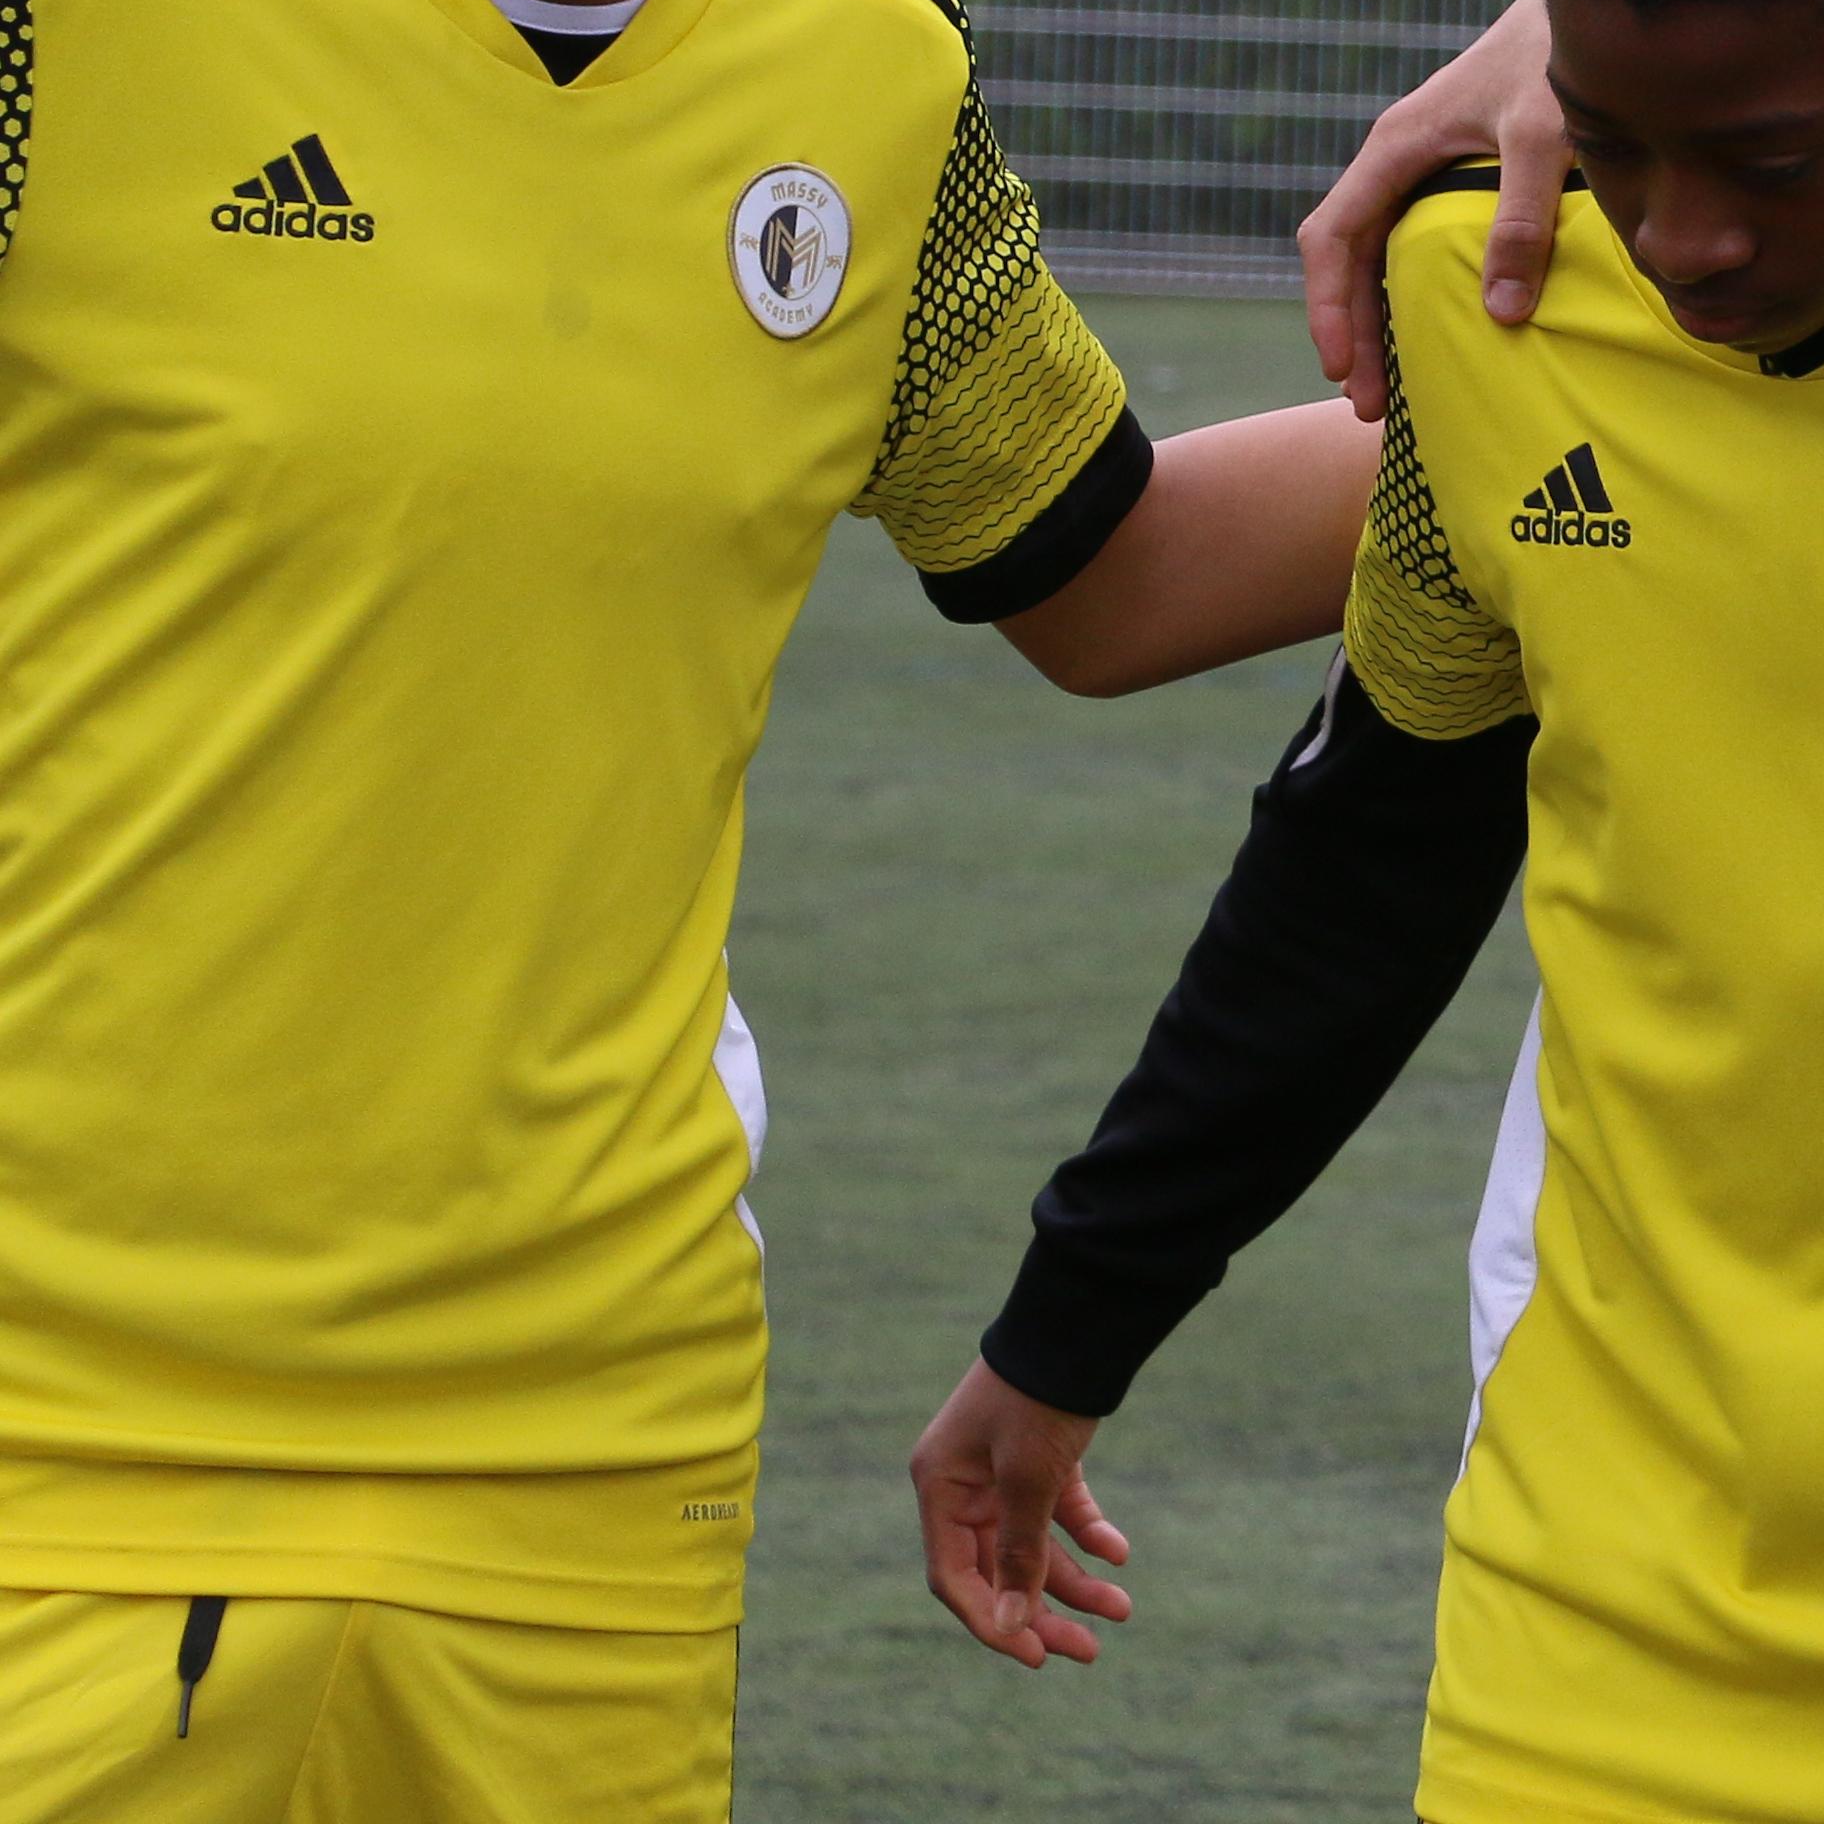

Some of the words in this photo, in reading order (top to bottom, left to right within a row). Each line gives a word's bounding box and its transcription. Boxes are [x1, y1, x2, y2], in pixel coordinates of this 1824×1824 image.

[771, 181, 828, 208] MASSY
[211, 199, 375, 243] adidas
[758, 292, 813, 324] ACADEMY
[1511, 509, 1631, 549] adidas
